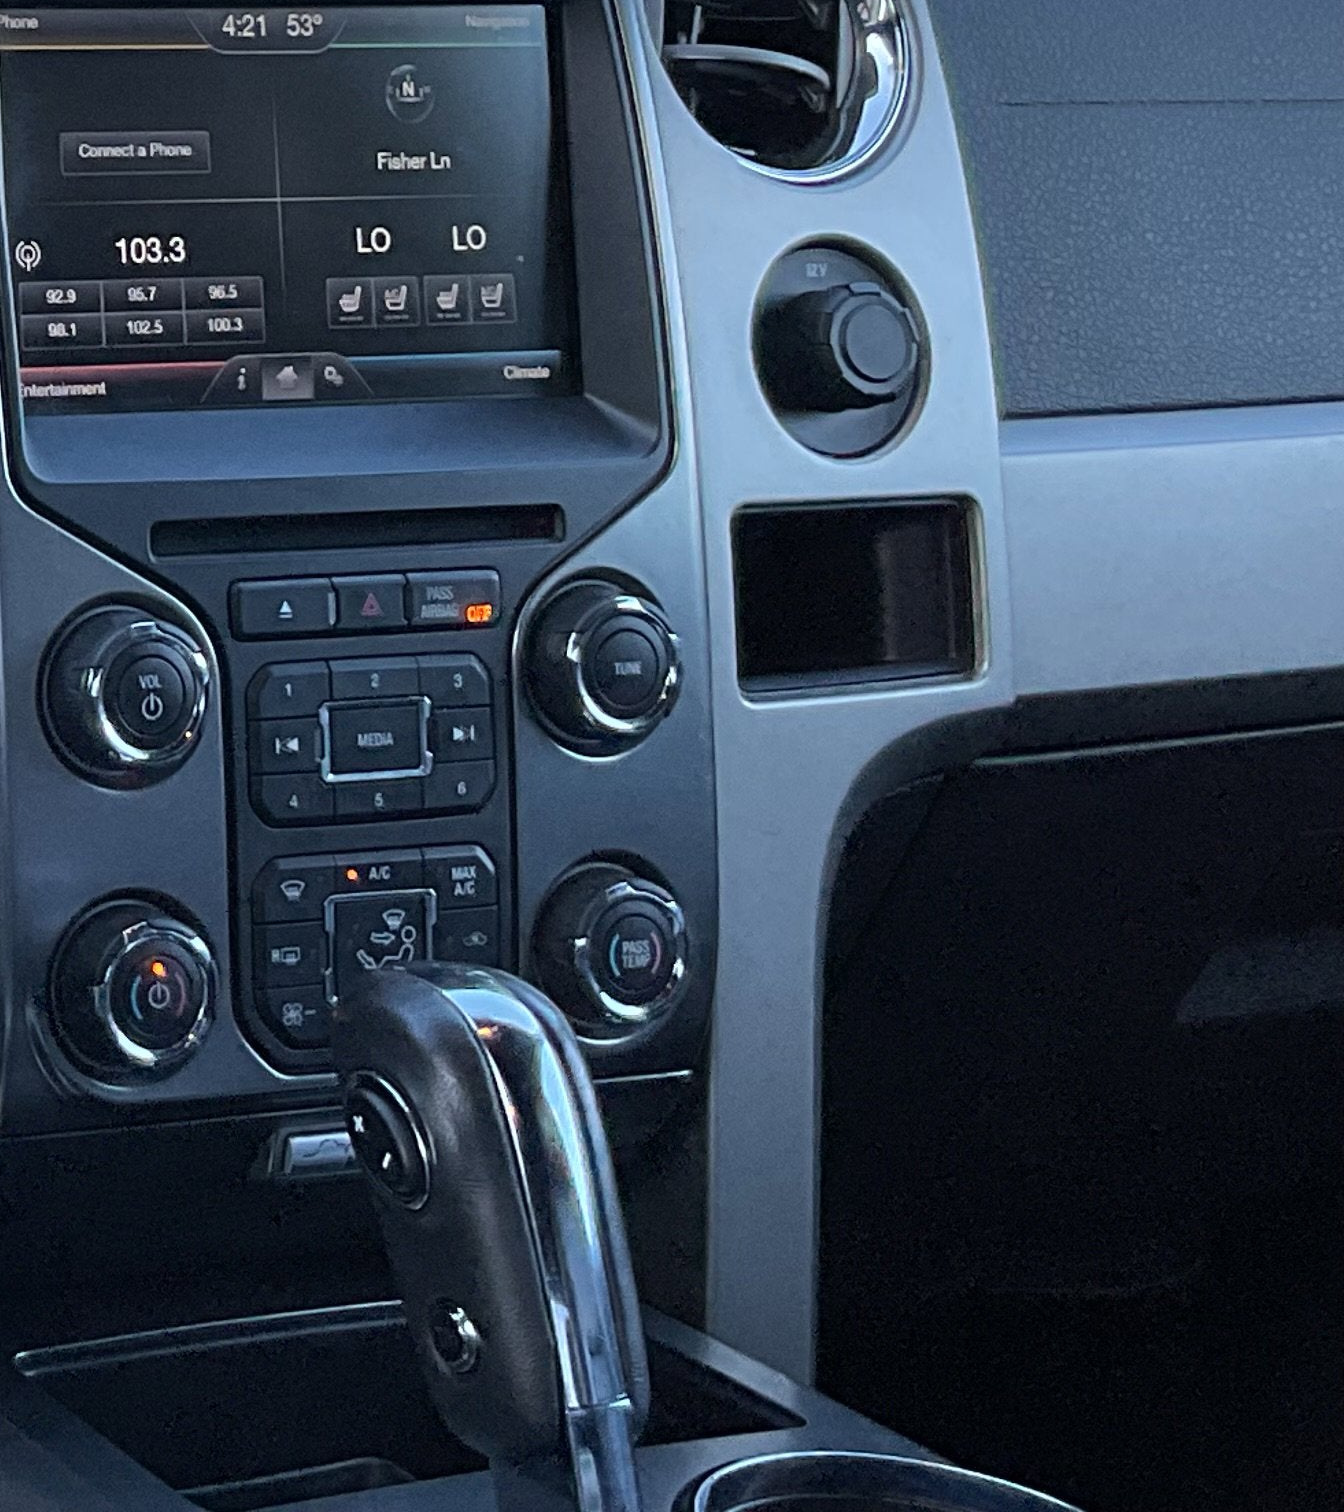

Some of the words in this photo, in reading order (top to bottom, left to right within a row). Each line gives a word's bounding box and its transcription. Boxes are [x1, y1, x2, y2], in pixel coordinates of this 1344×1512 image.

[221, 14, 268, 38] 4:21
[78, 143, 135, 158] Connect
[137, 146, 147, 157] a
[149, 142, 192, 157] Phone
[376, 151, 426, 170] Fisher
[429, 152, 451, 170] Ln
[355, 226, 392, 254] LO
[452, 224, 487, 252] LO
[114, 236, 187, 264] 103.3
[370, 673, 380, 688] 2
[453, 673, 463, 688] 3
[357, 732, 394, 747] MEDIA
[368, 866, 391, 881] A/C
[451, 866, 477, 880] MAX
[453, 881, 476, 896] A/C
[622, 940, 650, 955] PASS
